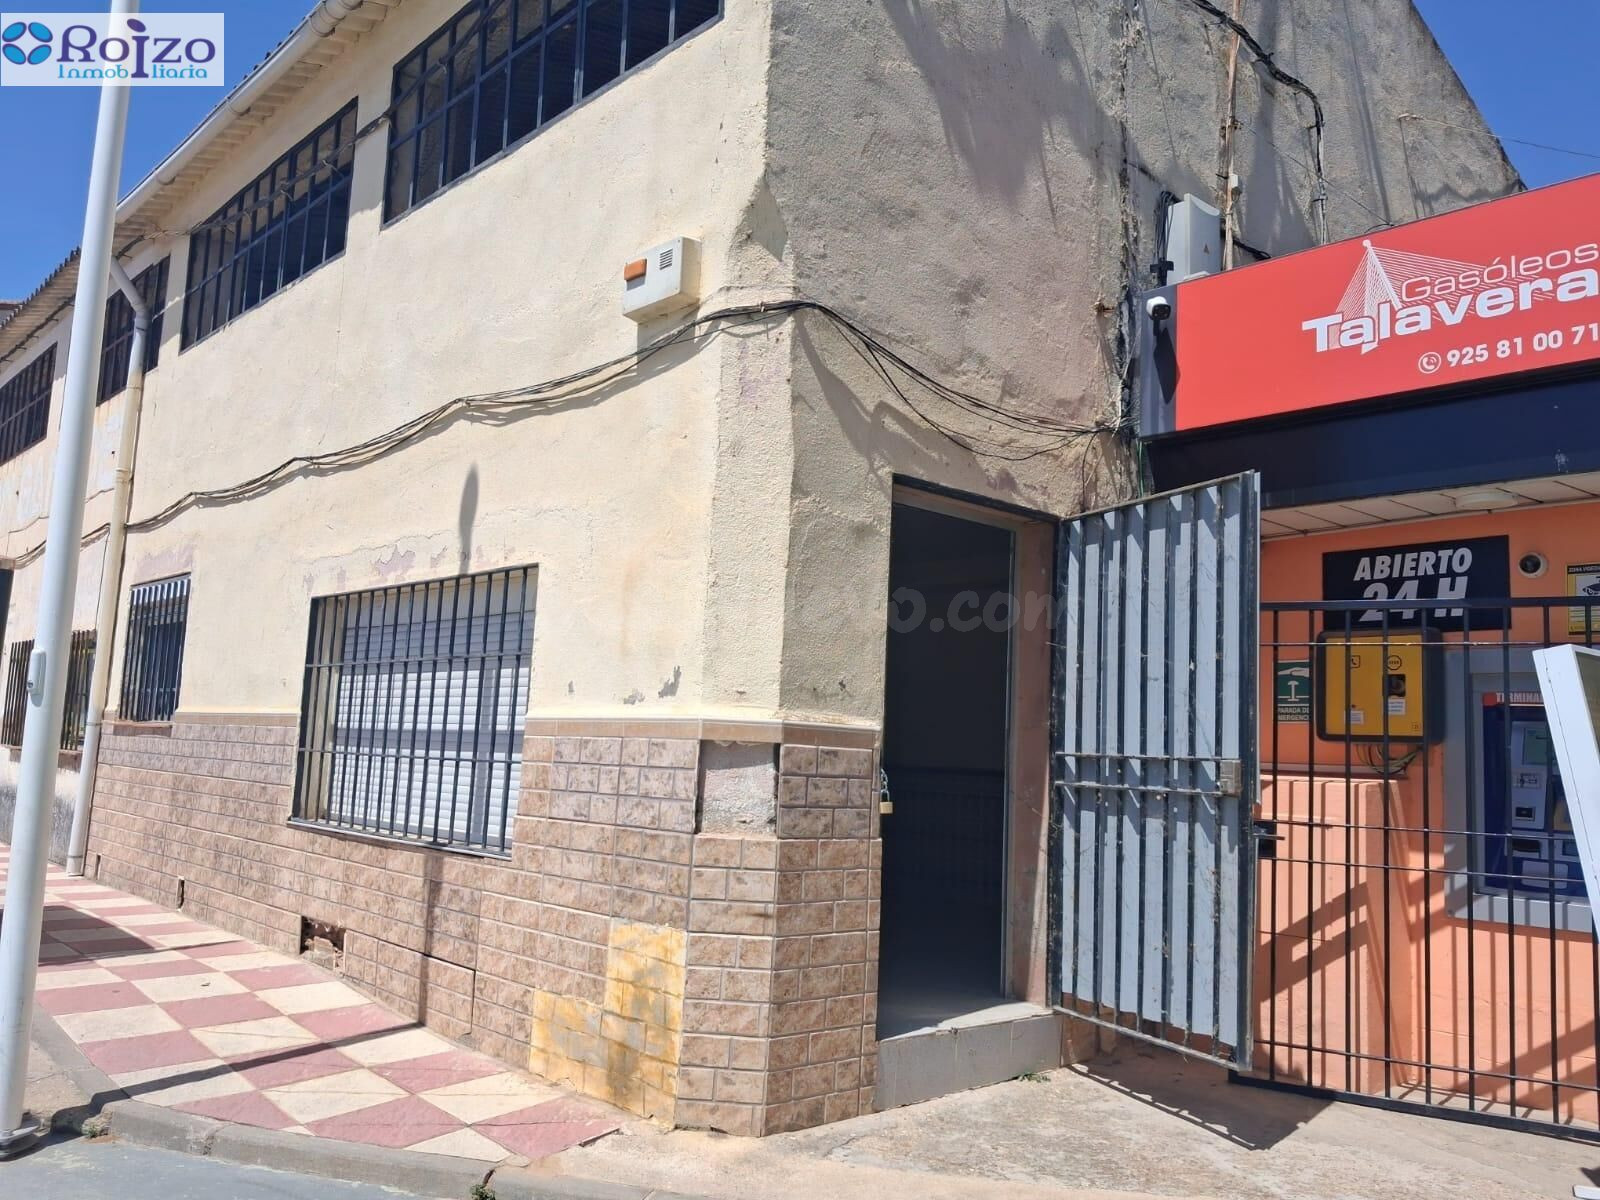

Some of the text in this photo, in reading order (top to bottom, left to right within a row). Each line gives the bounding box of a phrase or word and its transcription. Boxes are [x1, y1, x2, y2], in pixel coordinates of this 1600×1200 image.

[1401, 243, 1600, 302] Gasóleos
[1302, 268, 1600, 355] Talavera
[1447, 322, 1600, 367] 925 81 00 71
[1353, 547, 1473, 582] ABIERTO
[1359, 576, 1468, 622] 24 H
